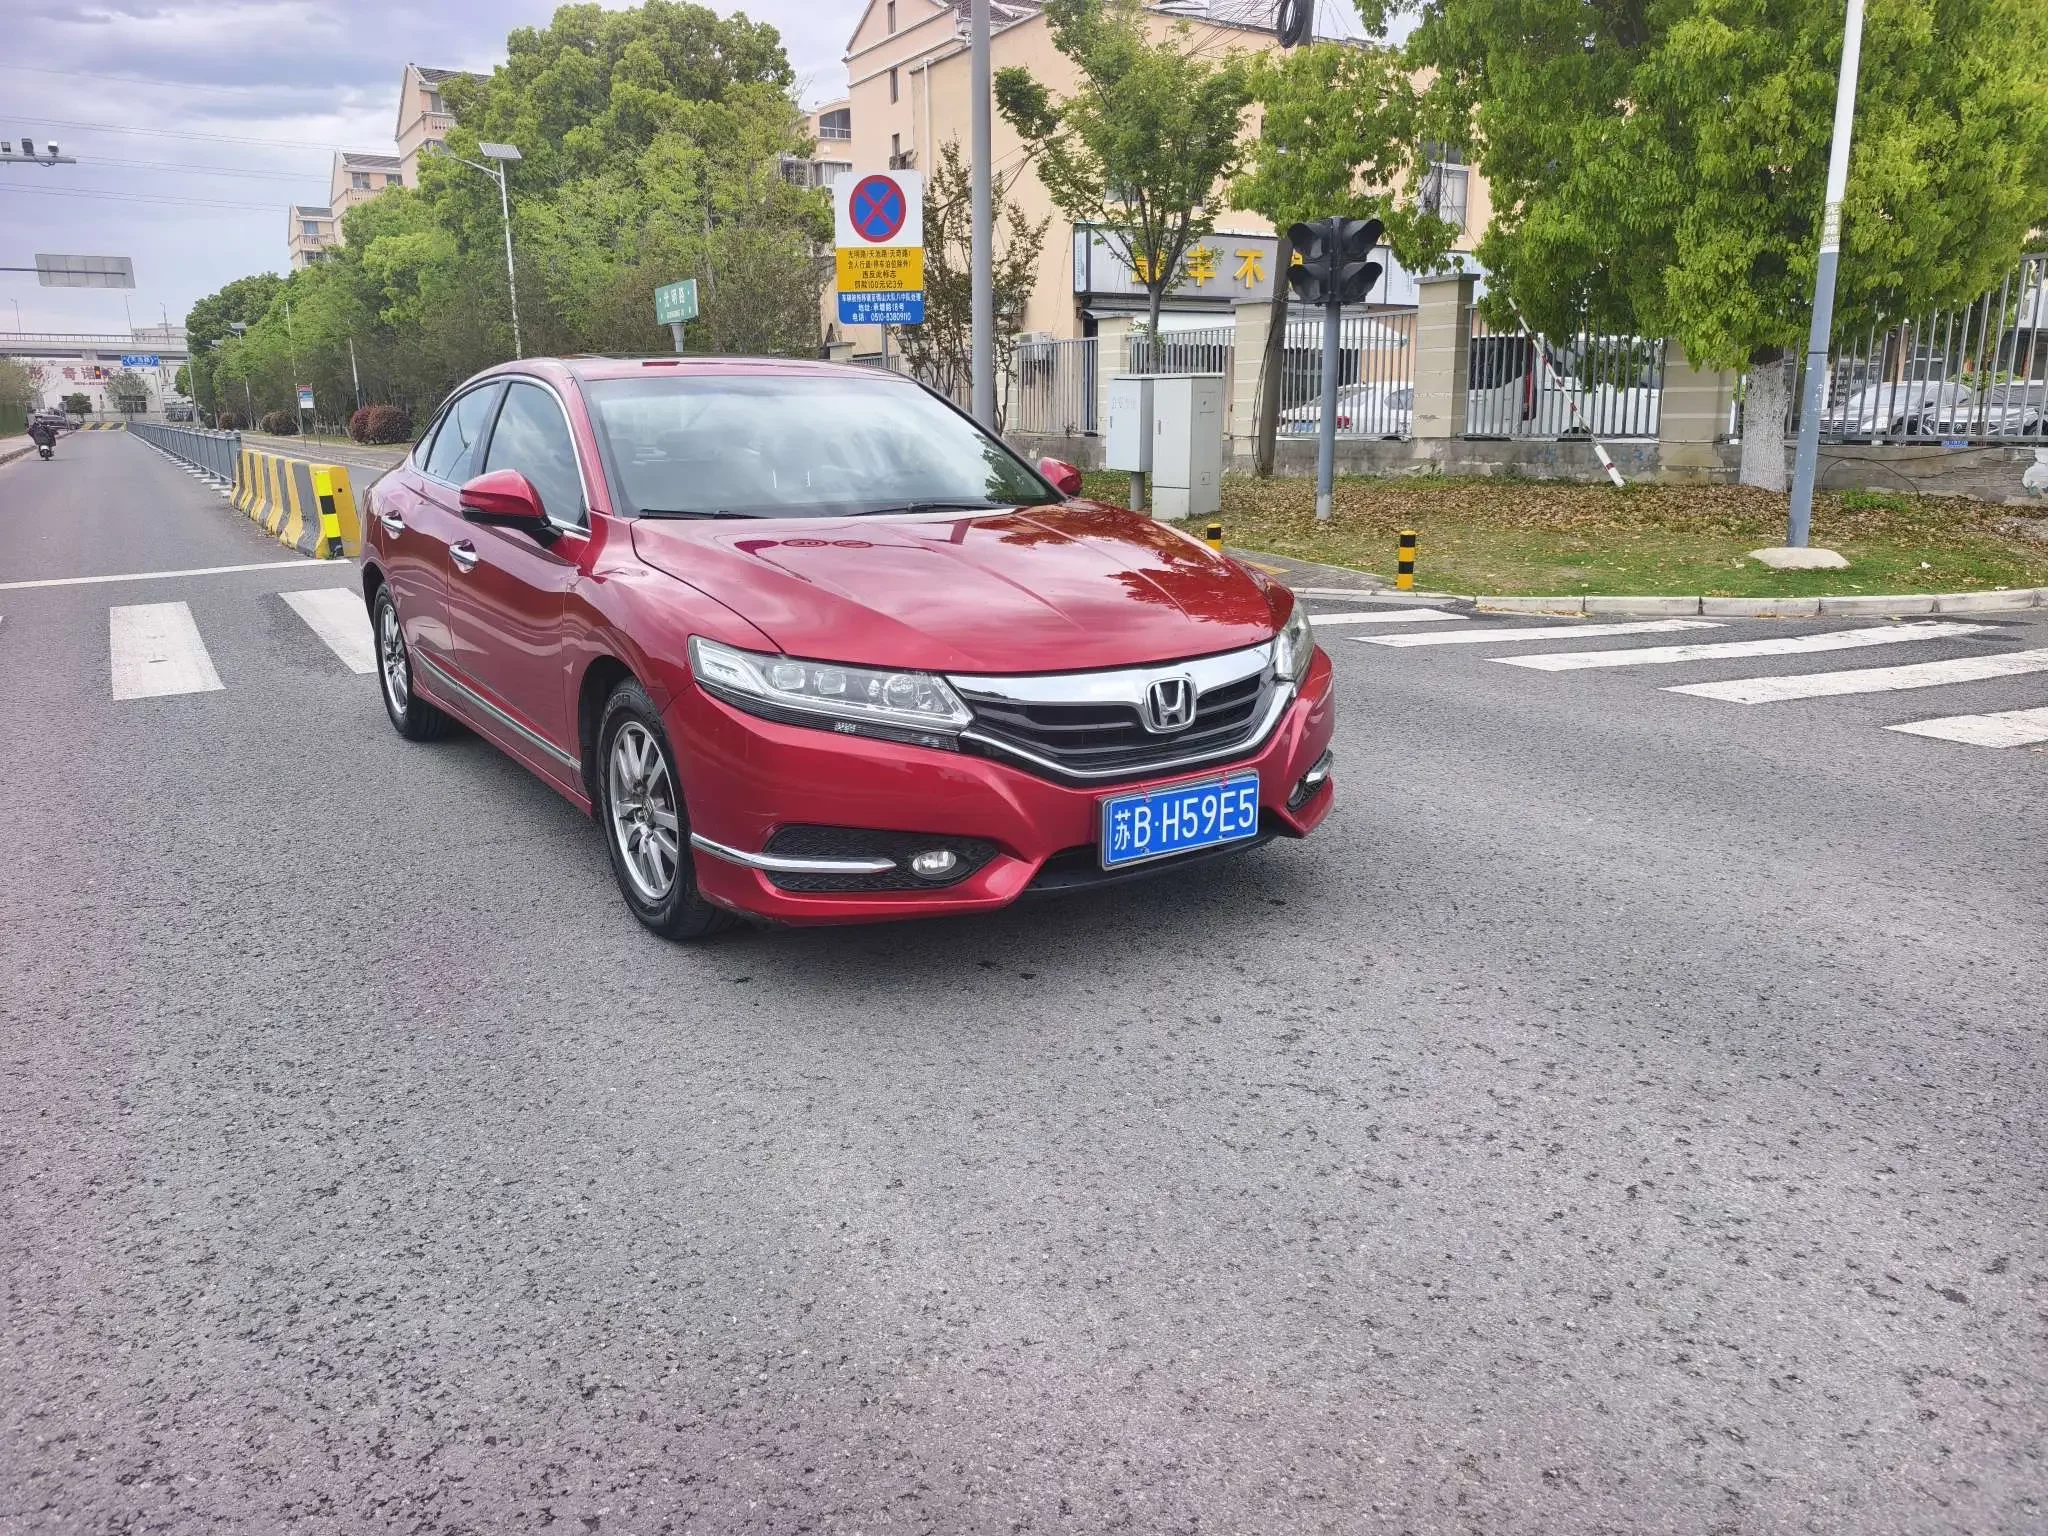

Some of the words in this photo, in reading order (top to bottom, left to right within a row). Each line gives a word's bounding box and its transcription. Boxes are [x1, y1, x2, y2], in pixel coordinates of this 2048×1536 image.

[862, 270, 897, 279] 违反此标志
[854, 280, 904, 289] 罚款100元记3分
